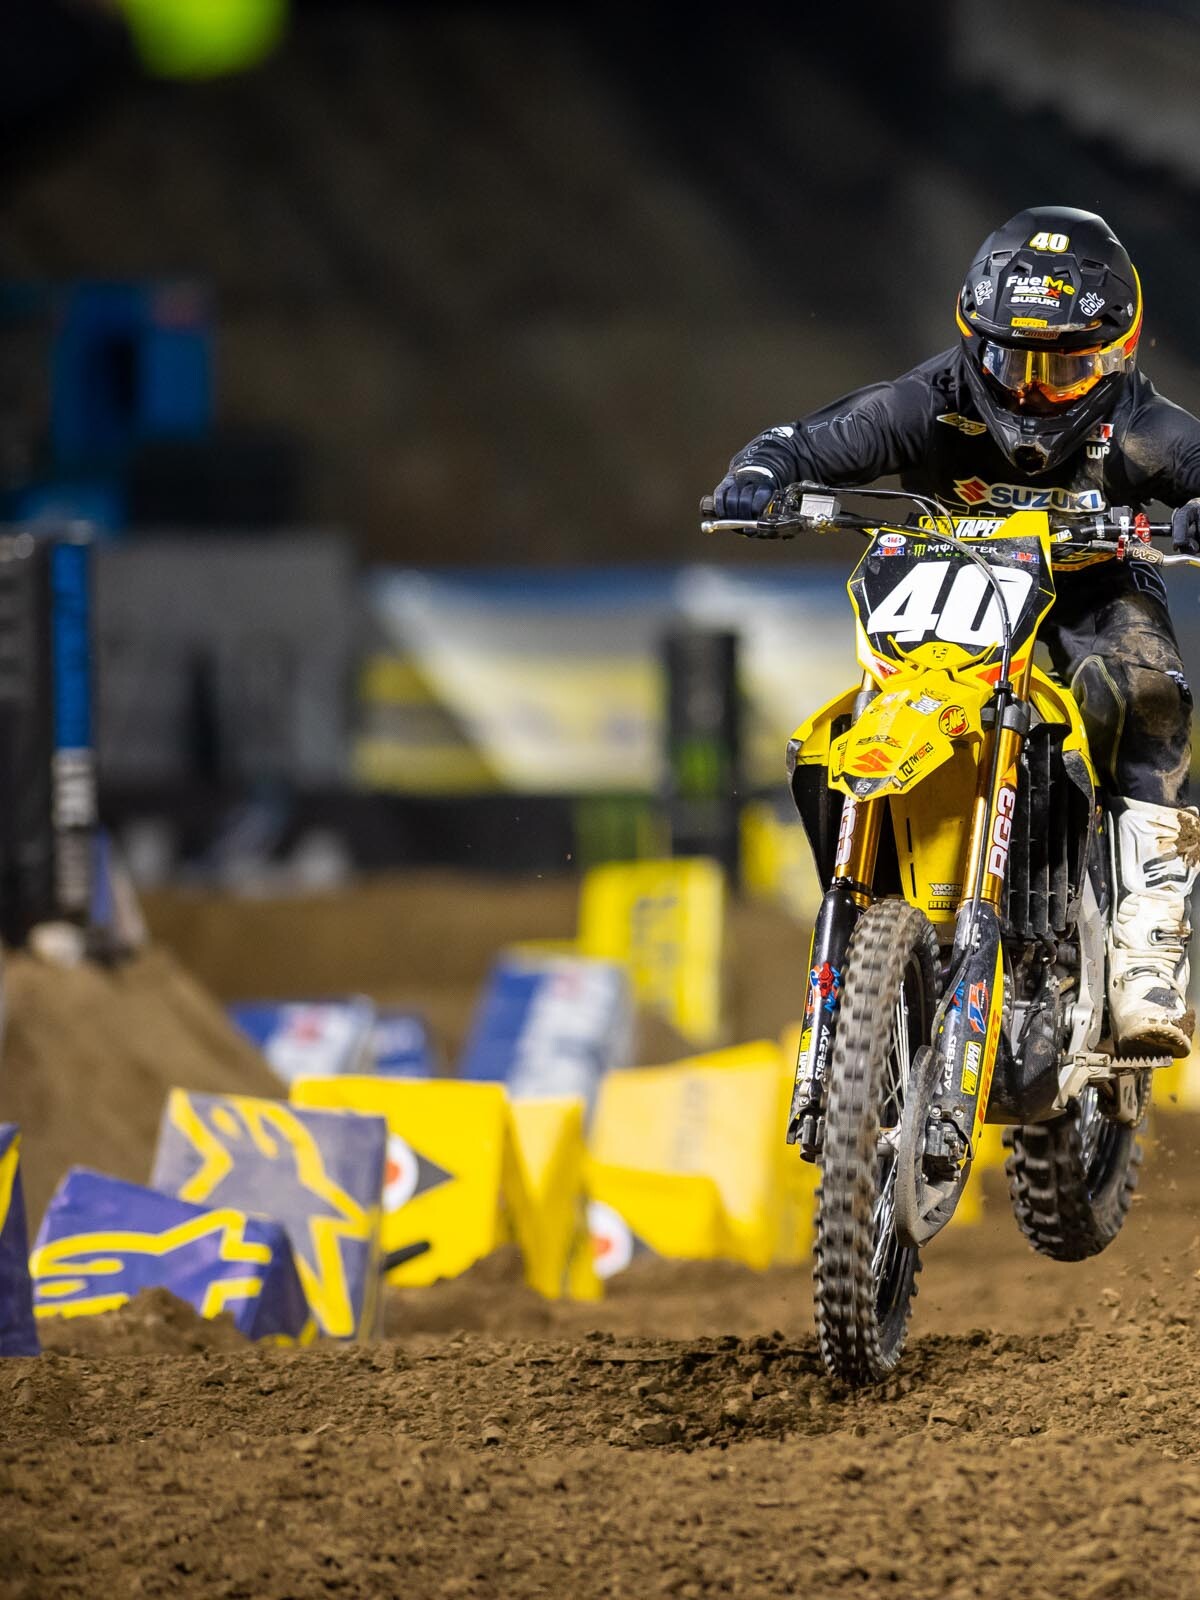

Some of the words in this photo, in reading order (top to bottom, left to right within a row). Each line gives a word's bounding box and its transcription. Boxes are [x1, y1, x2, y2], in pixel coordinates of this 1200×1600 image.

[1029, 232, 1070, 252] 40
[1006, 275, 1076, 295] FuelMe
[1010, 296, 1060, 308] SUZUKI
[991, 486, 1100, 510] SUZUKI
[866, 561, 1033, 647] 40
[943, 1036, 957, 1090] ACERBIS
